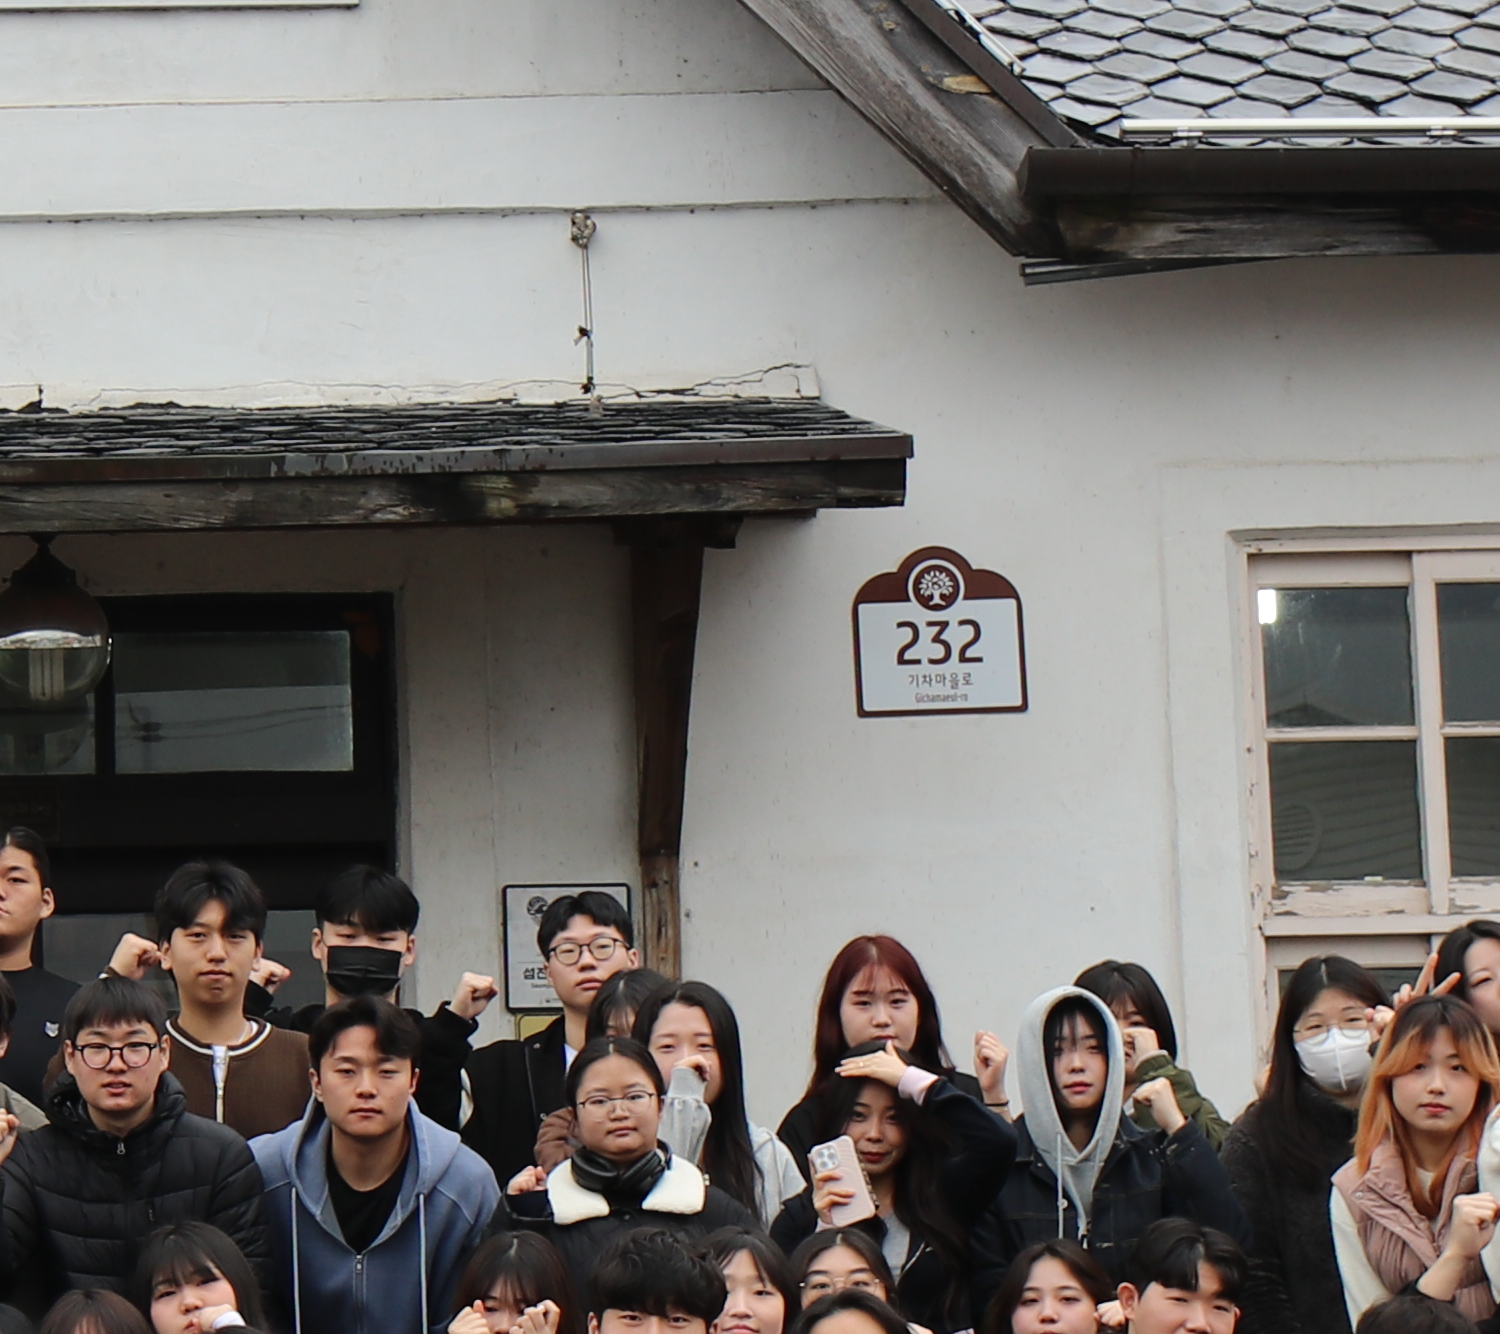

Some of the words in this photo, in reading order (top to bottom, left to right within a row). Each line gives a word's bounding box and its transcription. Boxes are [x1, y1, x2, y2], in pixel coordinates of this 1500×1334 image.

[896, 619, 983, 665] 232
[908, 672, 974, 689] 기차마을로
[914, 692, 969, 703] Gichamaeul-ro
